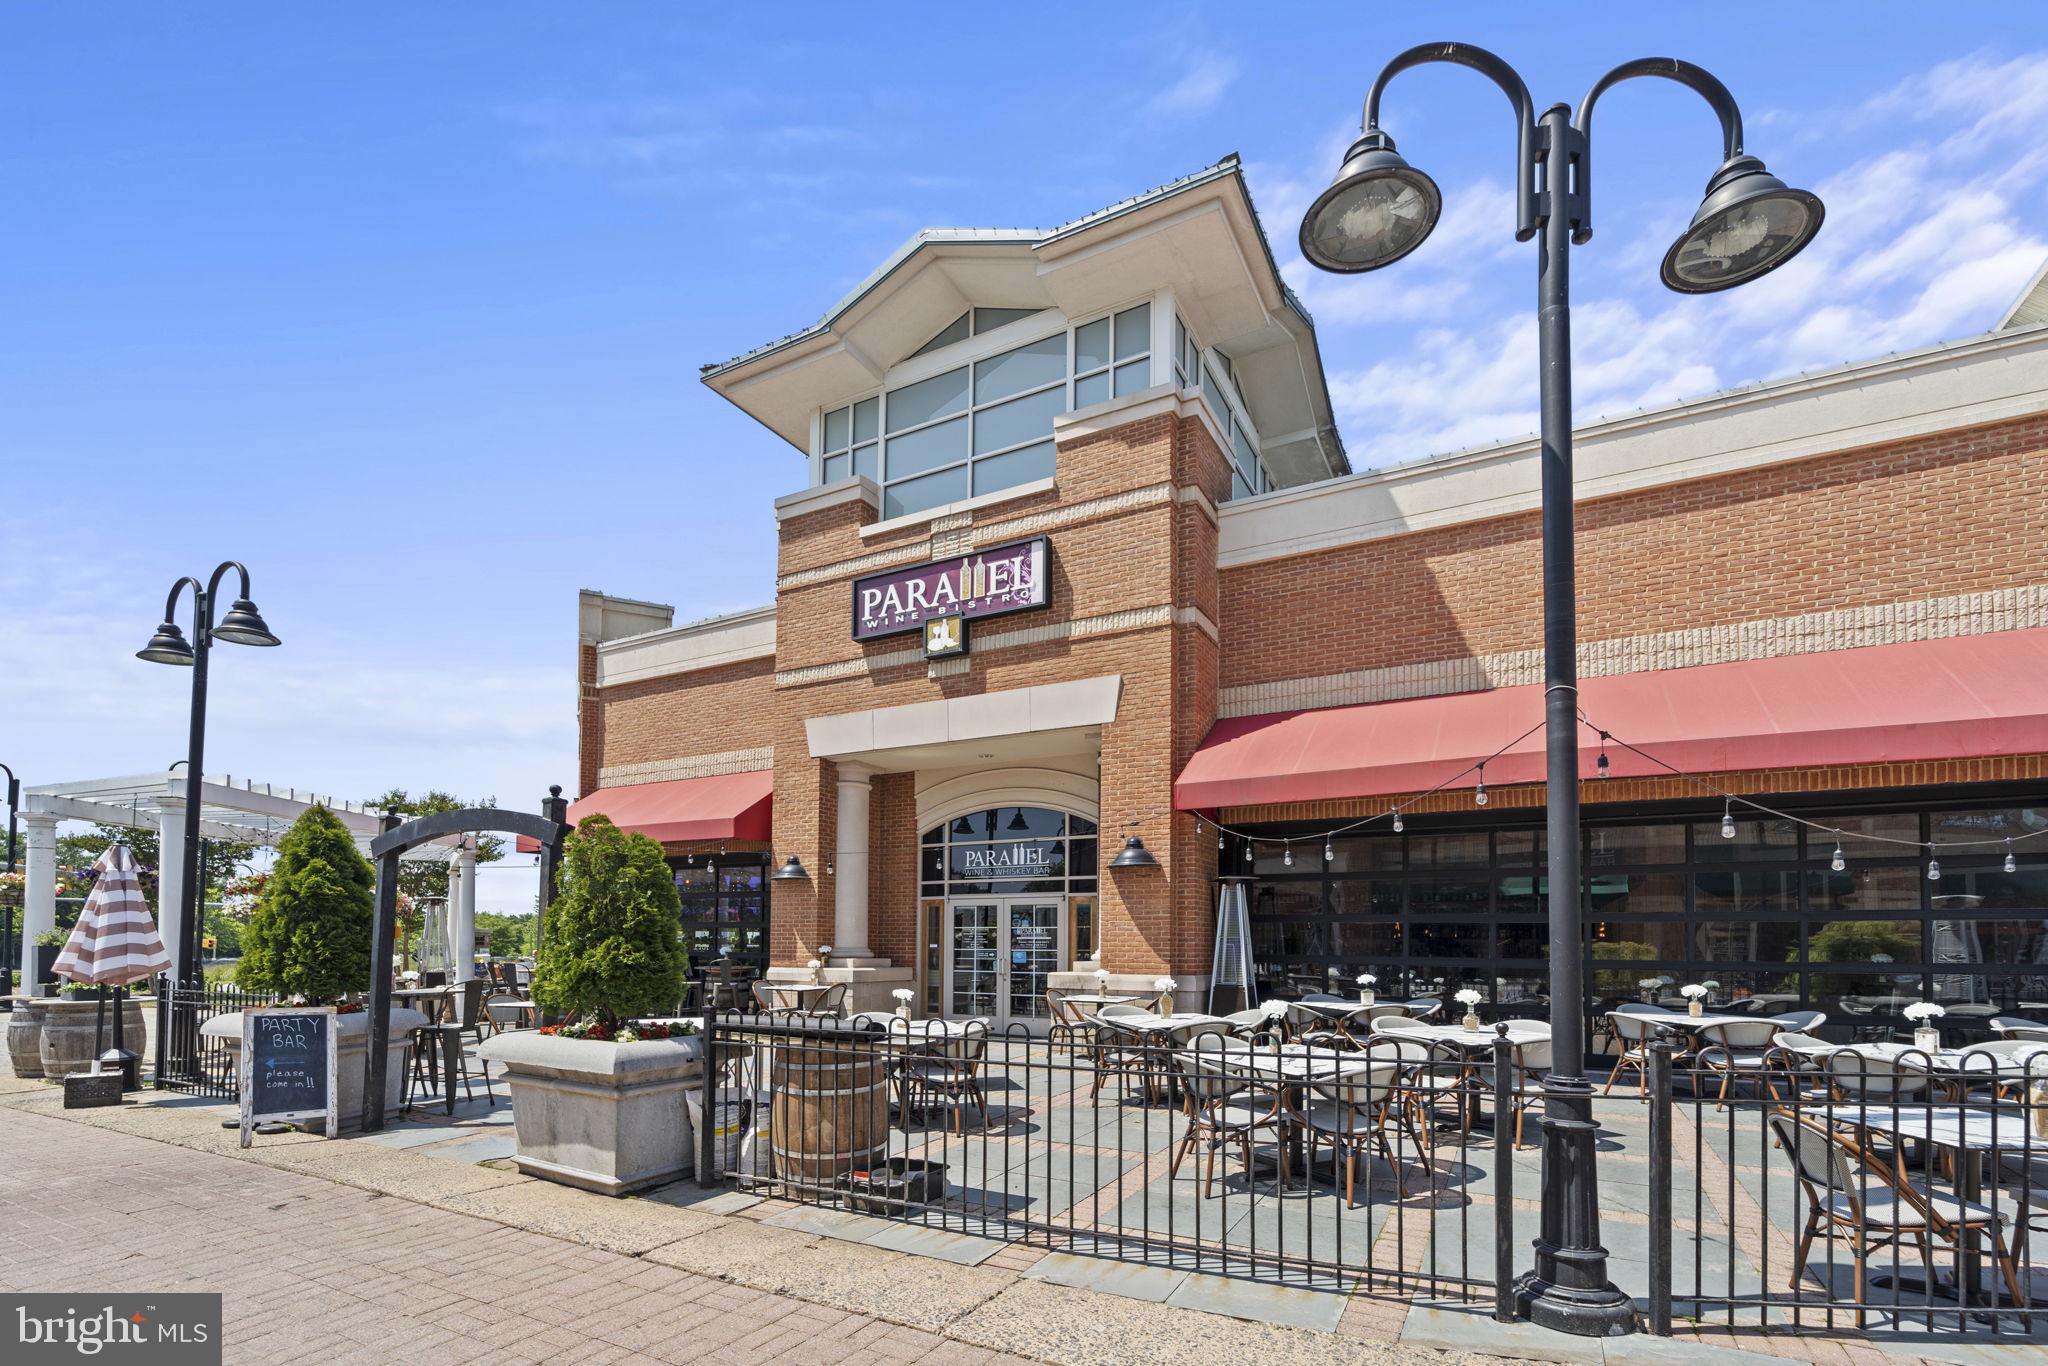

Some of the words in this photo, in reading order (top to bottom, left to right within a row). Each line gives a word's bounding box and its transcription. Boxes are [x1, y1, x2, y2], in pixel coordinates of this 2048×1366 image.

[867, 611, 919, 629] WINE
[938, 590, 1029, 615] BISTRO
[965, 867, 986, 876] WINE
[987, 868, 993, 876] &
[994, 867, 1031, 876] WHISKEY
[1033, 866, 1050, 875] BAR
[262, 1017, 320, 1034] PARTY
[272, 1033, 307, 1049] BAR
[266, 1069, 305, 1080] please
[266, 1080, 288, 1088] come
